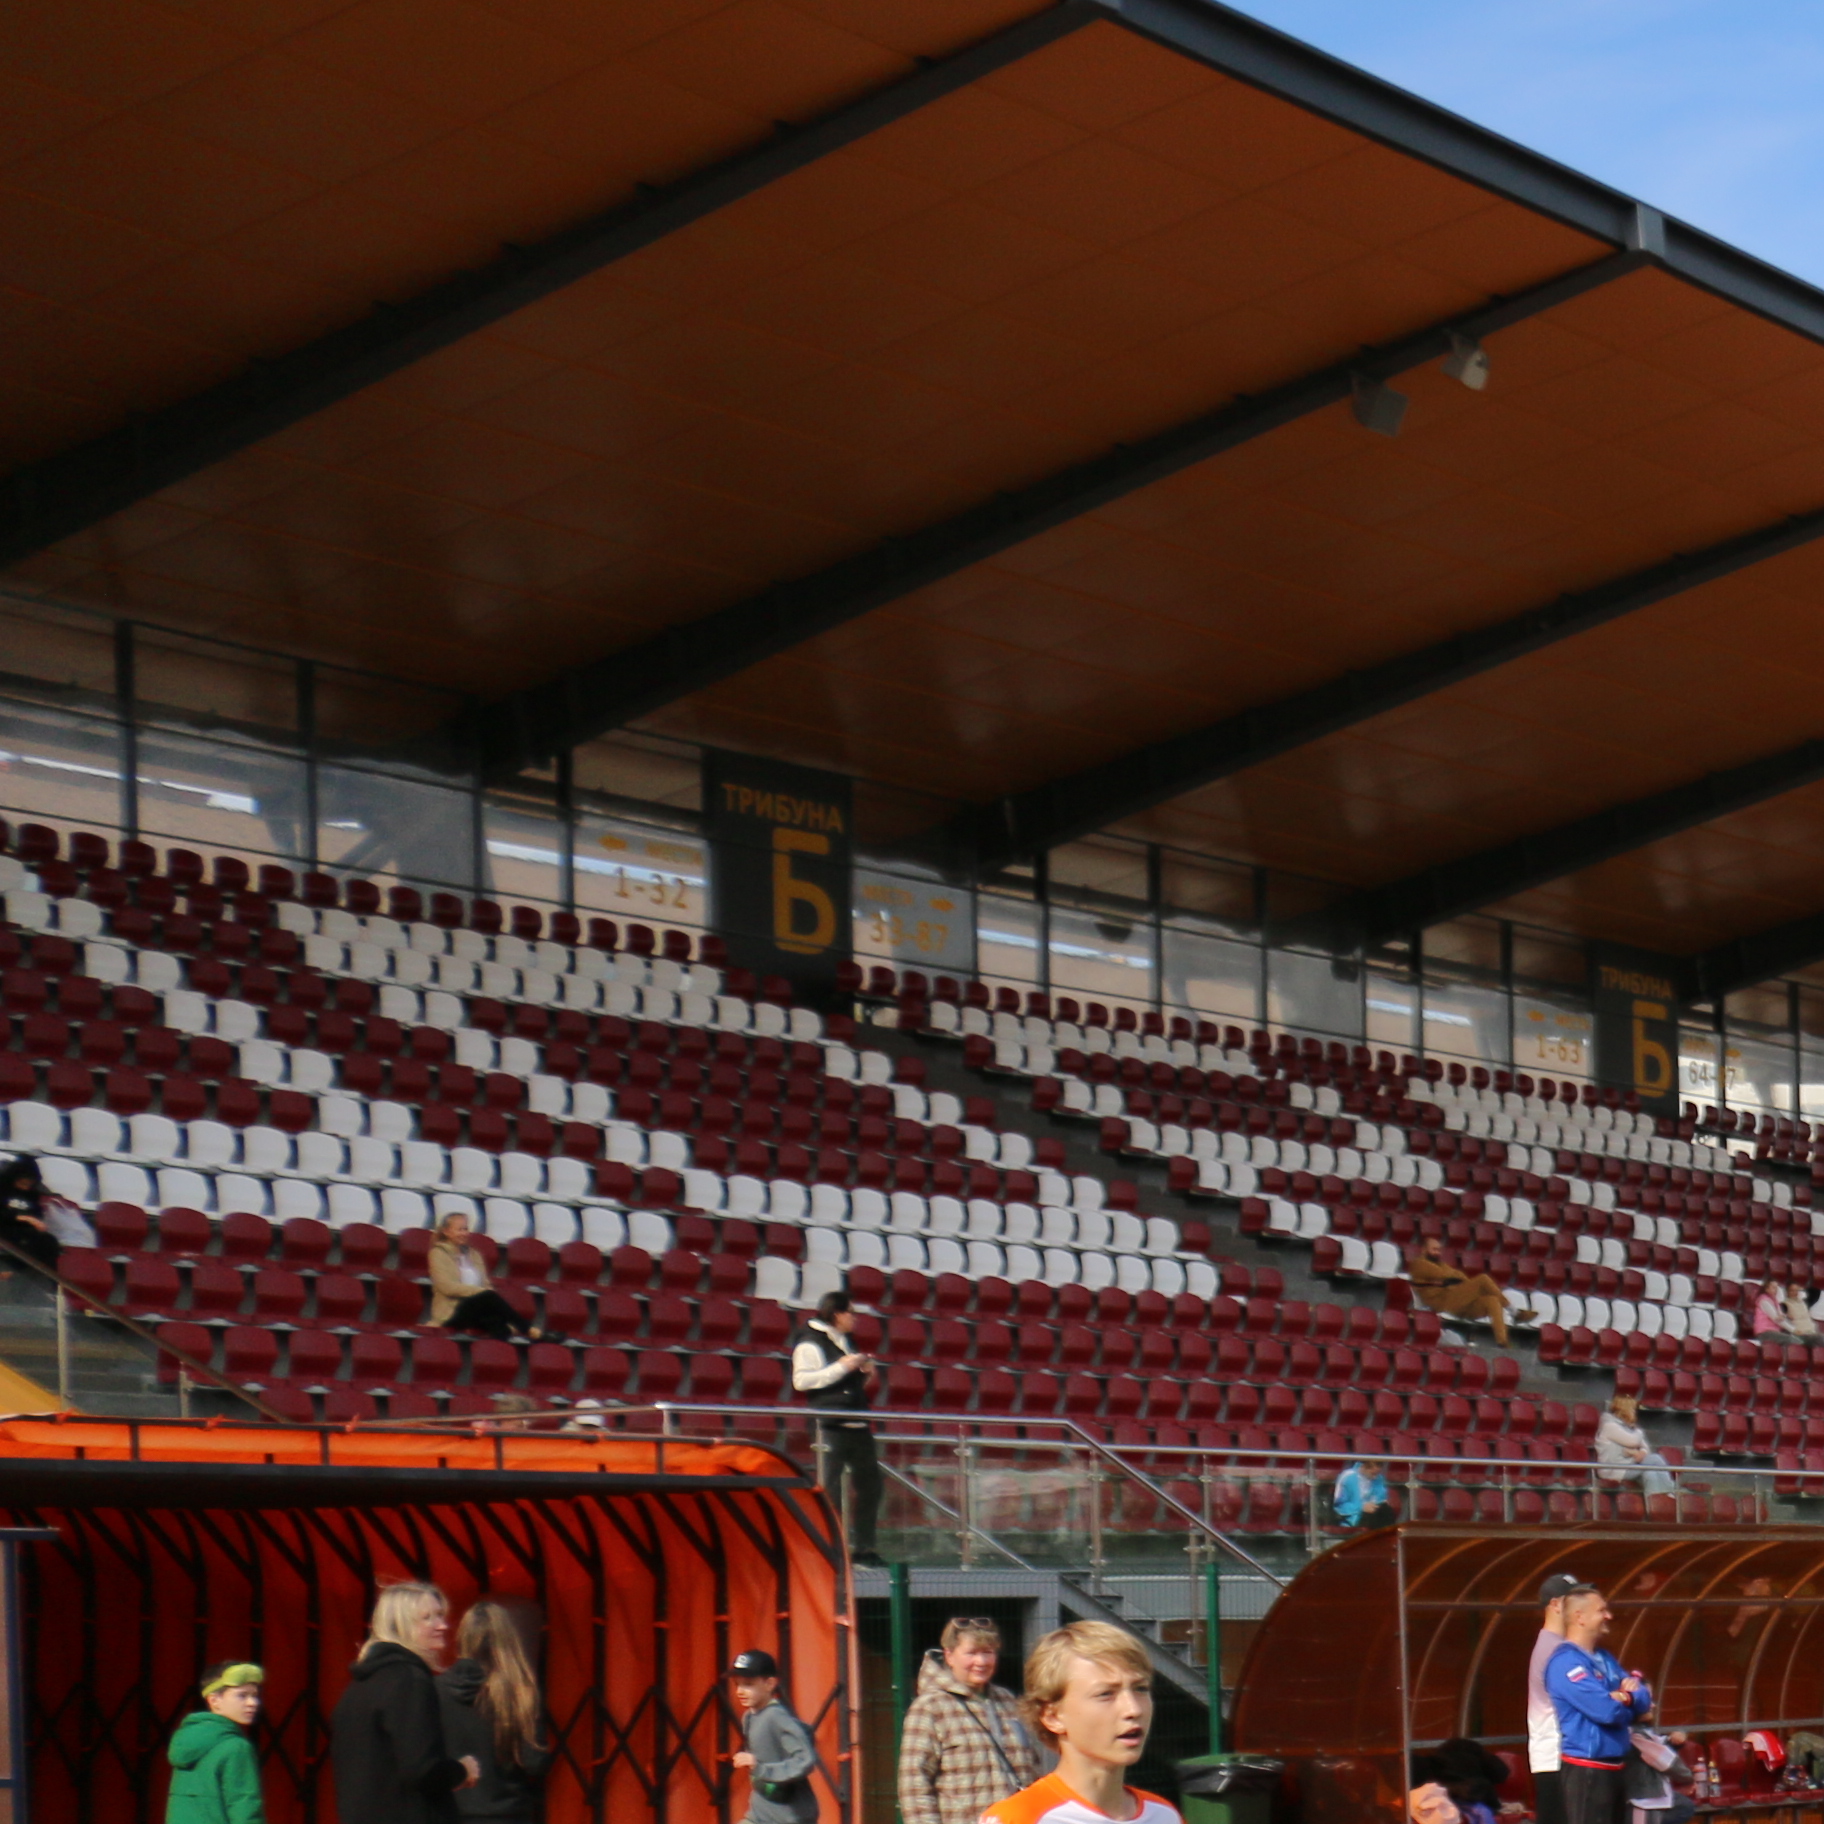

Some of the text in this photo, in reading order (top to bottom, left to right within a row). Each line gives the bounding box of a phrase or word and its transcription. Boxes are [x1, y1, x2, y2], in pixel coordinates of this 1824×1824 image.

[721, 782, 845, 834] ТРИБУНА
[613, 866, 688, 910] 1-32
[772, 826, 838, 955] Б
[868, 911, 950, 953] 33-87
[1599, 965, 1672, 999] ТРИБУНА
[1536, 1034, 1581, 1065] 1-63
[1632, 1000, 1672, 1098] Б
